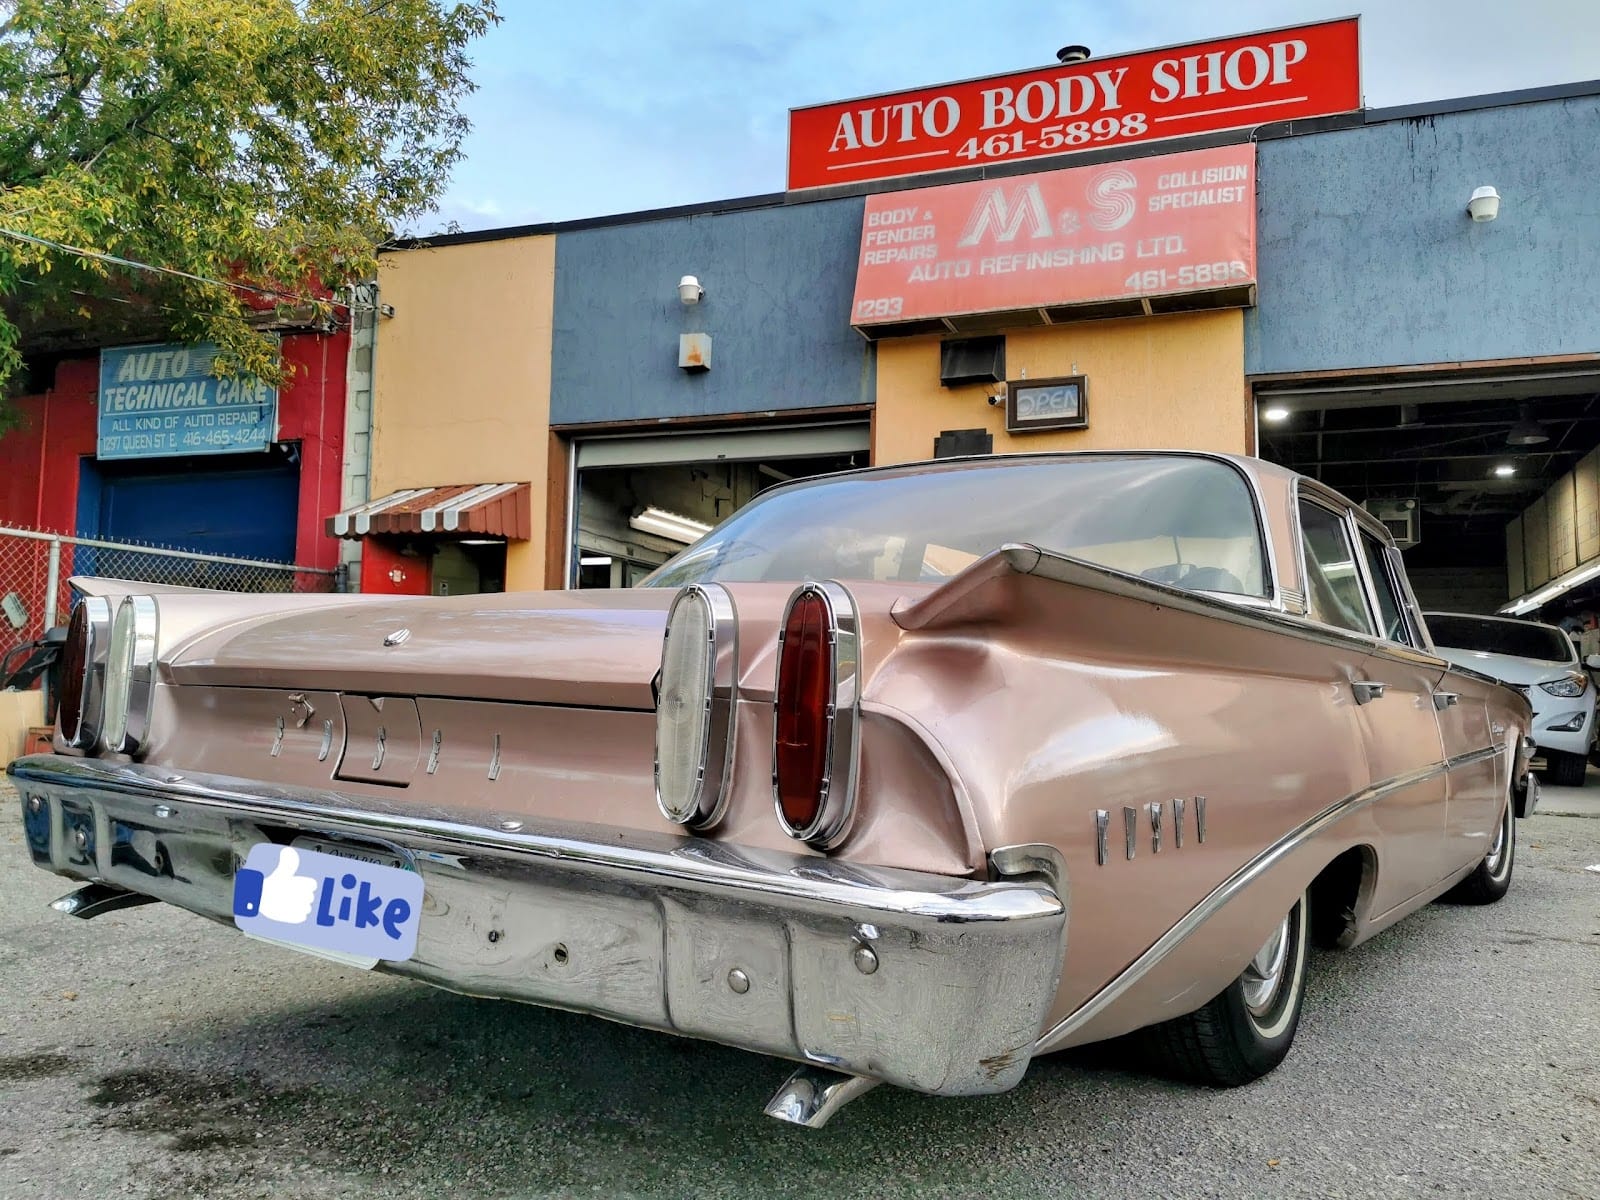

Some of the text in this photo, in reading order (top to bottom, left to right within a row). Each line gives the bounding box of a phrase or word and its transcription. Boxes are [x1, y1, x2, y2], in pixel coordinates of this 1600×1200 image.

[828, 39, 1308, 153] AUTO BODY SHOP
[955, 111, 1149, 161] 461-5898
[1157, 164, 1248, 190] COLLISION
[957, 181, 1055, 249] M
[1085, 168, 1139, 232] S
[1148, 186, 1246, 213] SPECIALIST
[868, 207, 919, 227] BODY
[865, 224, 936, 247] FENDER
[864, 244, 938, 266] REPAIRS
[907, 234, 1187, 284] AUTO REFINISHING LTD.
[1124, 260, 1250, 290] 461-5898
[856, 296, 904, 318] 1293
[119, 350, 189, 382] AUTO
[105, 376, 267, 412] TECHNICAL CARE
[112, 411, 259, 433] ALL KIND OF AUTO REPAIR
[122, 434, 152, 453] QUEEN
[154, 432, 166, 448] ST
